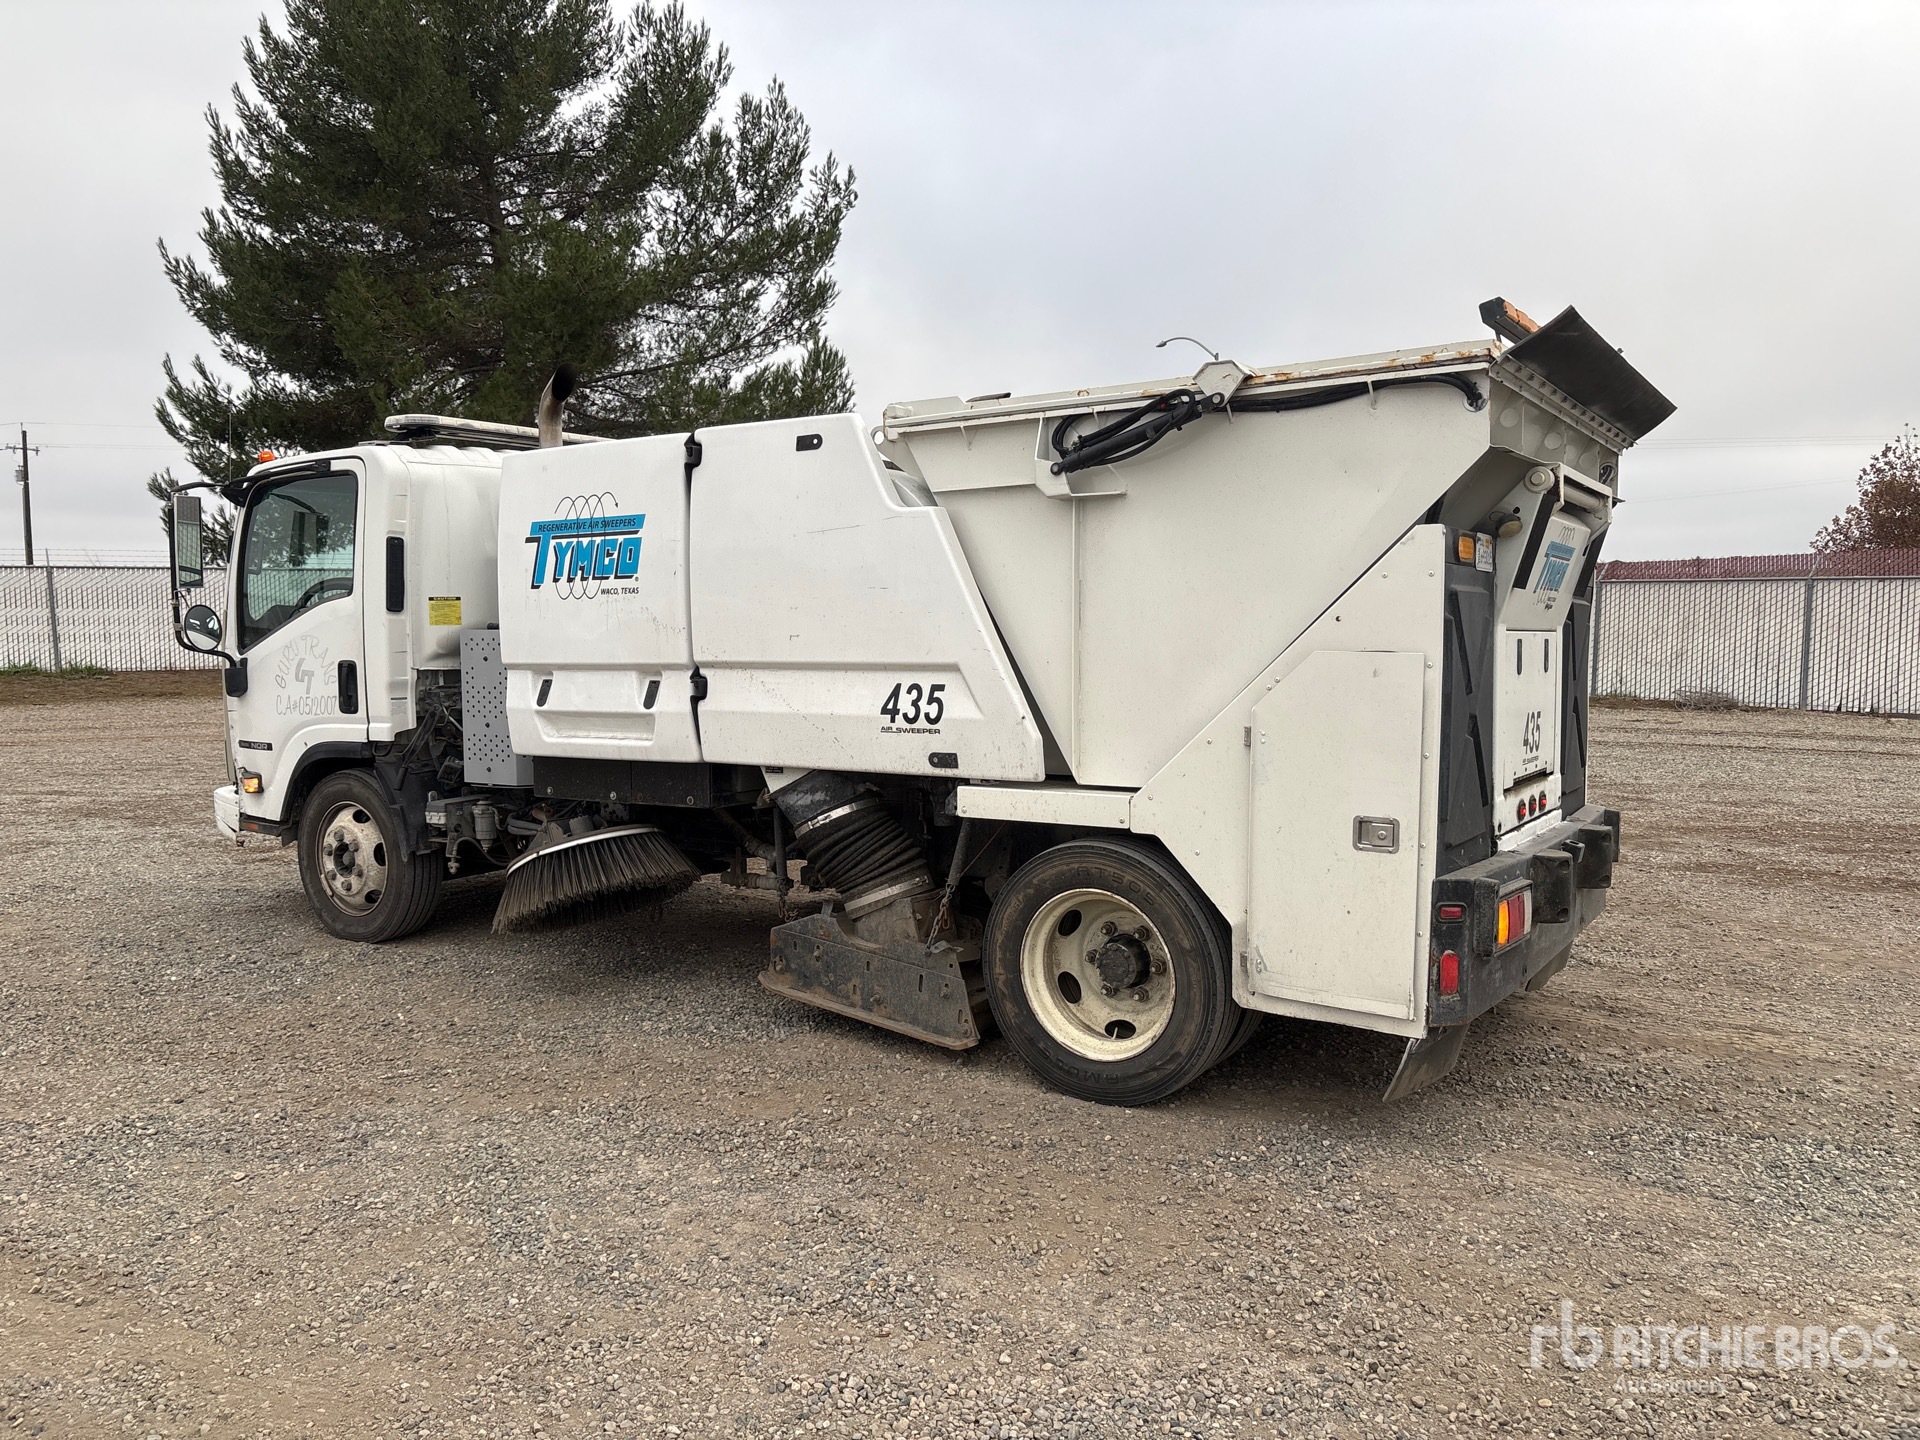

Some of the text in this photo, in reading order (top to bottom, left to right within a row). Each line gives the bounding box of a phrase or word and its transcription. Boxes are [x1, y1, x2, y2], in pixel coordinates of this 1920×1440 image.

[538, 518, 636, 533] REGENERATIVE AIR SWEEPERS
[525, 514, 646, 589] TYMCO
[600, 587, 639, 596] WACO, TEXAS
[275, 635, 337, 688] GURU TRANS
[880, 683, 946, 725] 435
[1523, 711, 1541, 754] 435
